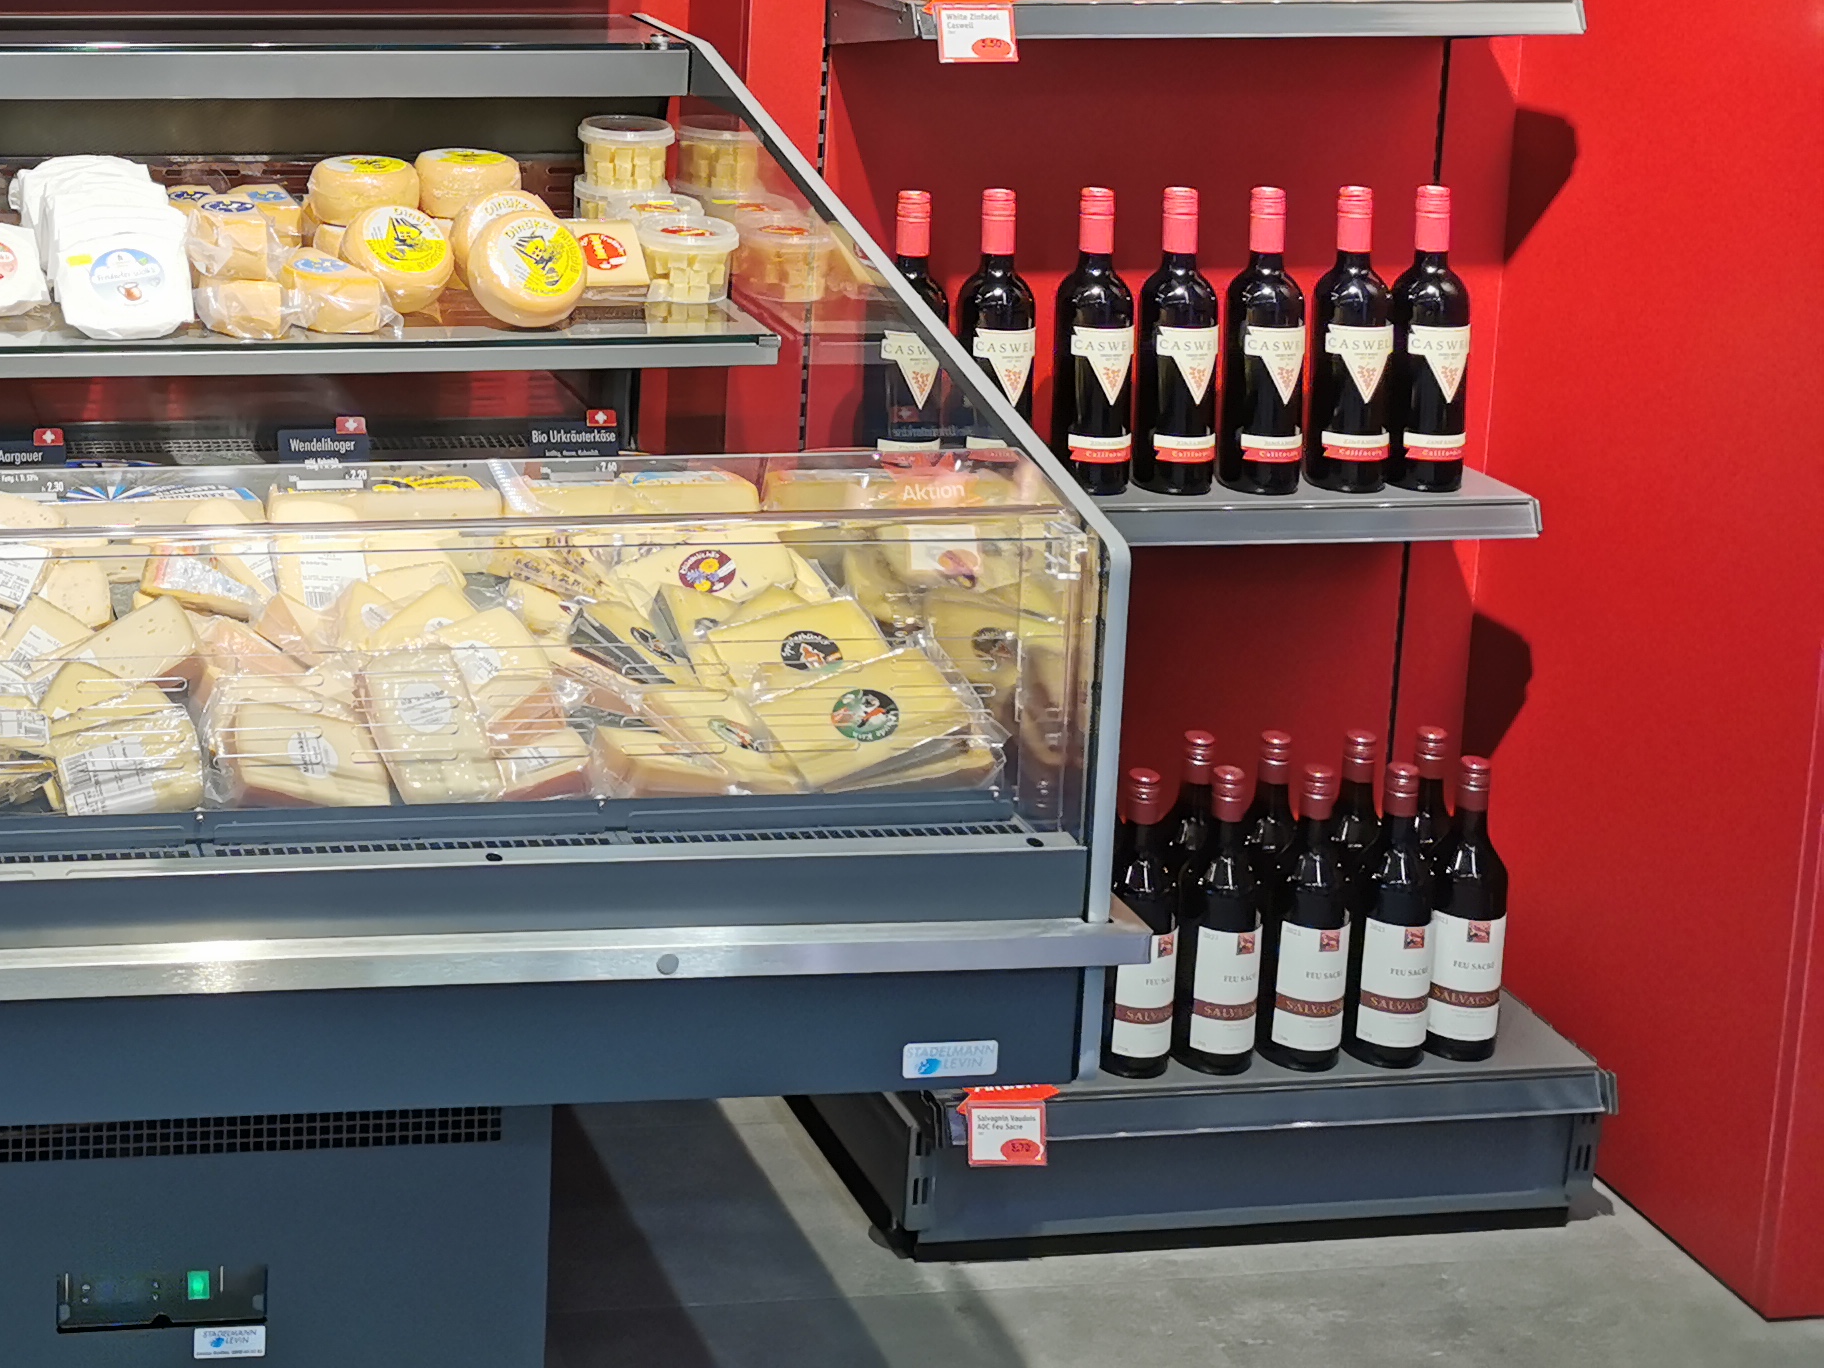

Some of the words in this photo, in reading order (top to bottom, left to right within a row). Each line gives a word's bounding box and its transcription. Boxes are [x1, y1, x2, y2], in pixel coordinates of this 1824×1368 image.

[946, 13, 968, 21] White
[970, 13, 1001, 21] Zinfadel
[947, 22, 974, 30] Caswell
[504, 218, 558, 240] Dintiker
[531, 430, 547, 444] Bio
[549, 429, 617, 445] Urkräuterkäse
[289, 437, 356, 454] Wendelihoger
[350, 469, 368, 481] 2.20
[46, 481, 64, 493] 2.30
[902, 483, 966, 502] Aktion
[905, 1043, 997, 1059] STADELMANN
[943, 1056, 984, 1070] LEVIN
[993, 1123, 1005, 1131] Feu
[202, 1329, 258, 1338] STADELMANN
[225, 1337, 250, 1345] LEVIN
